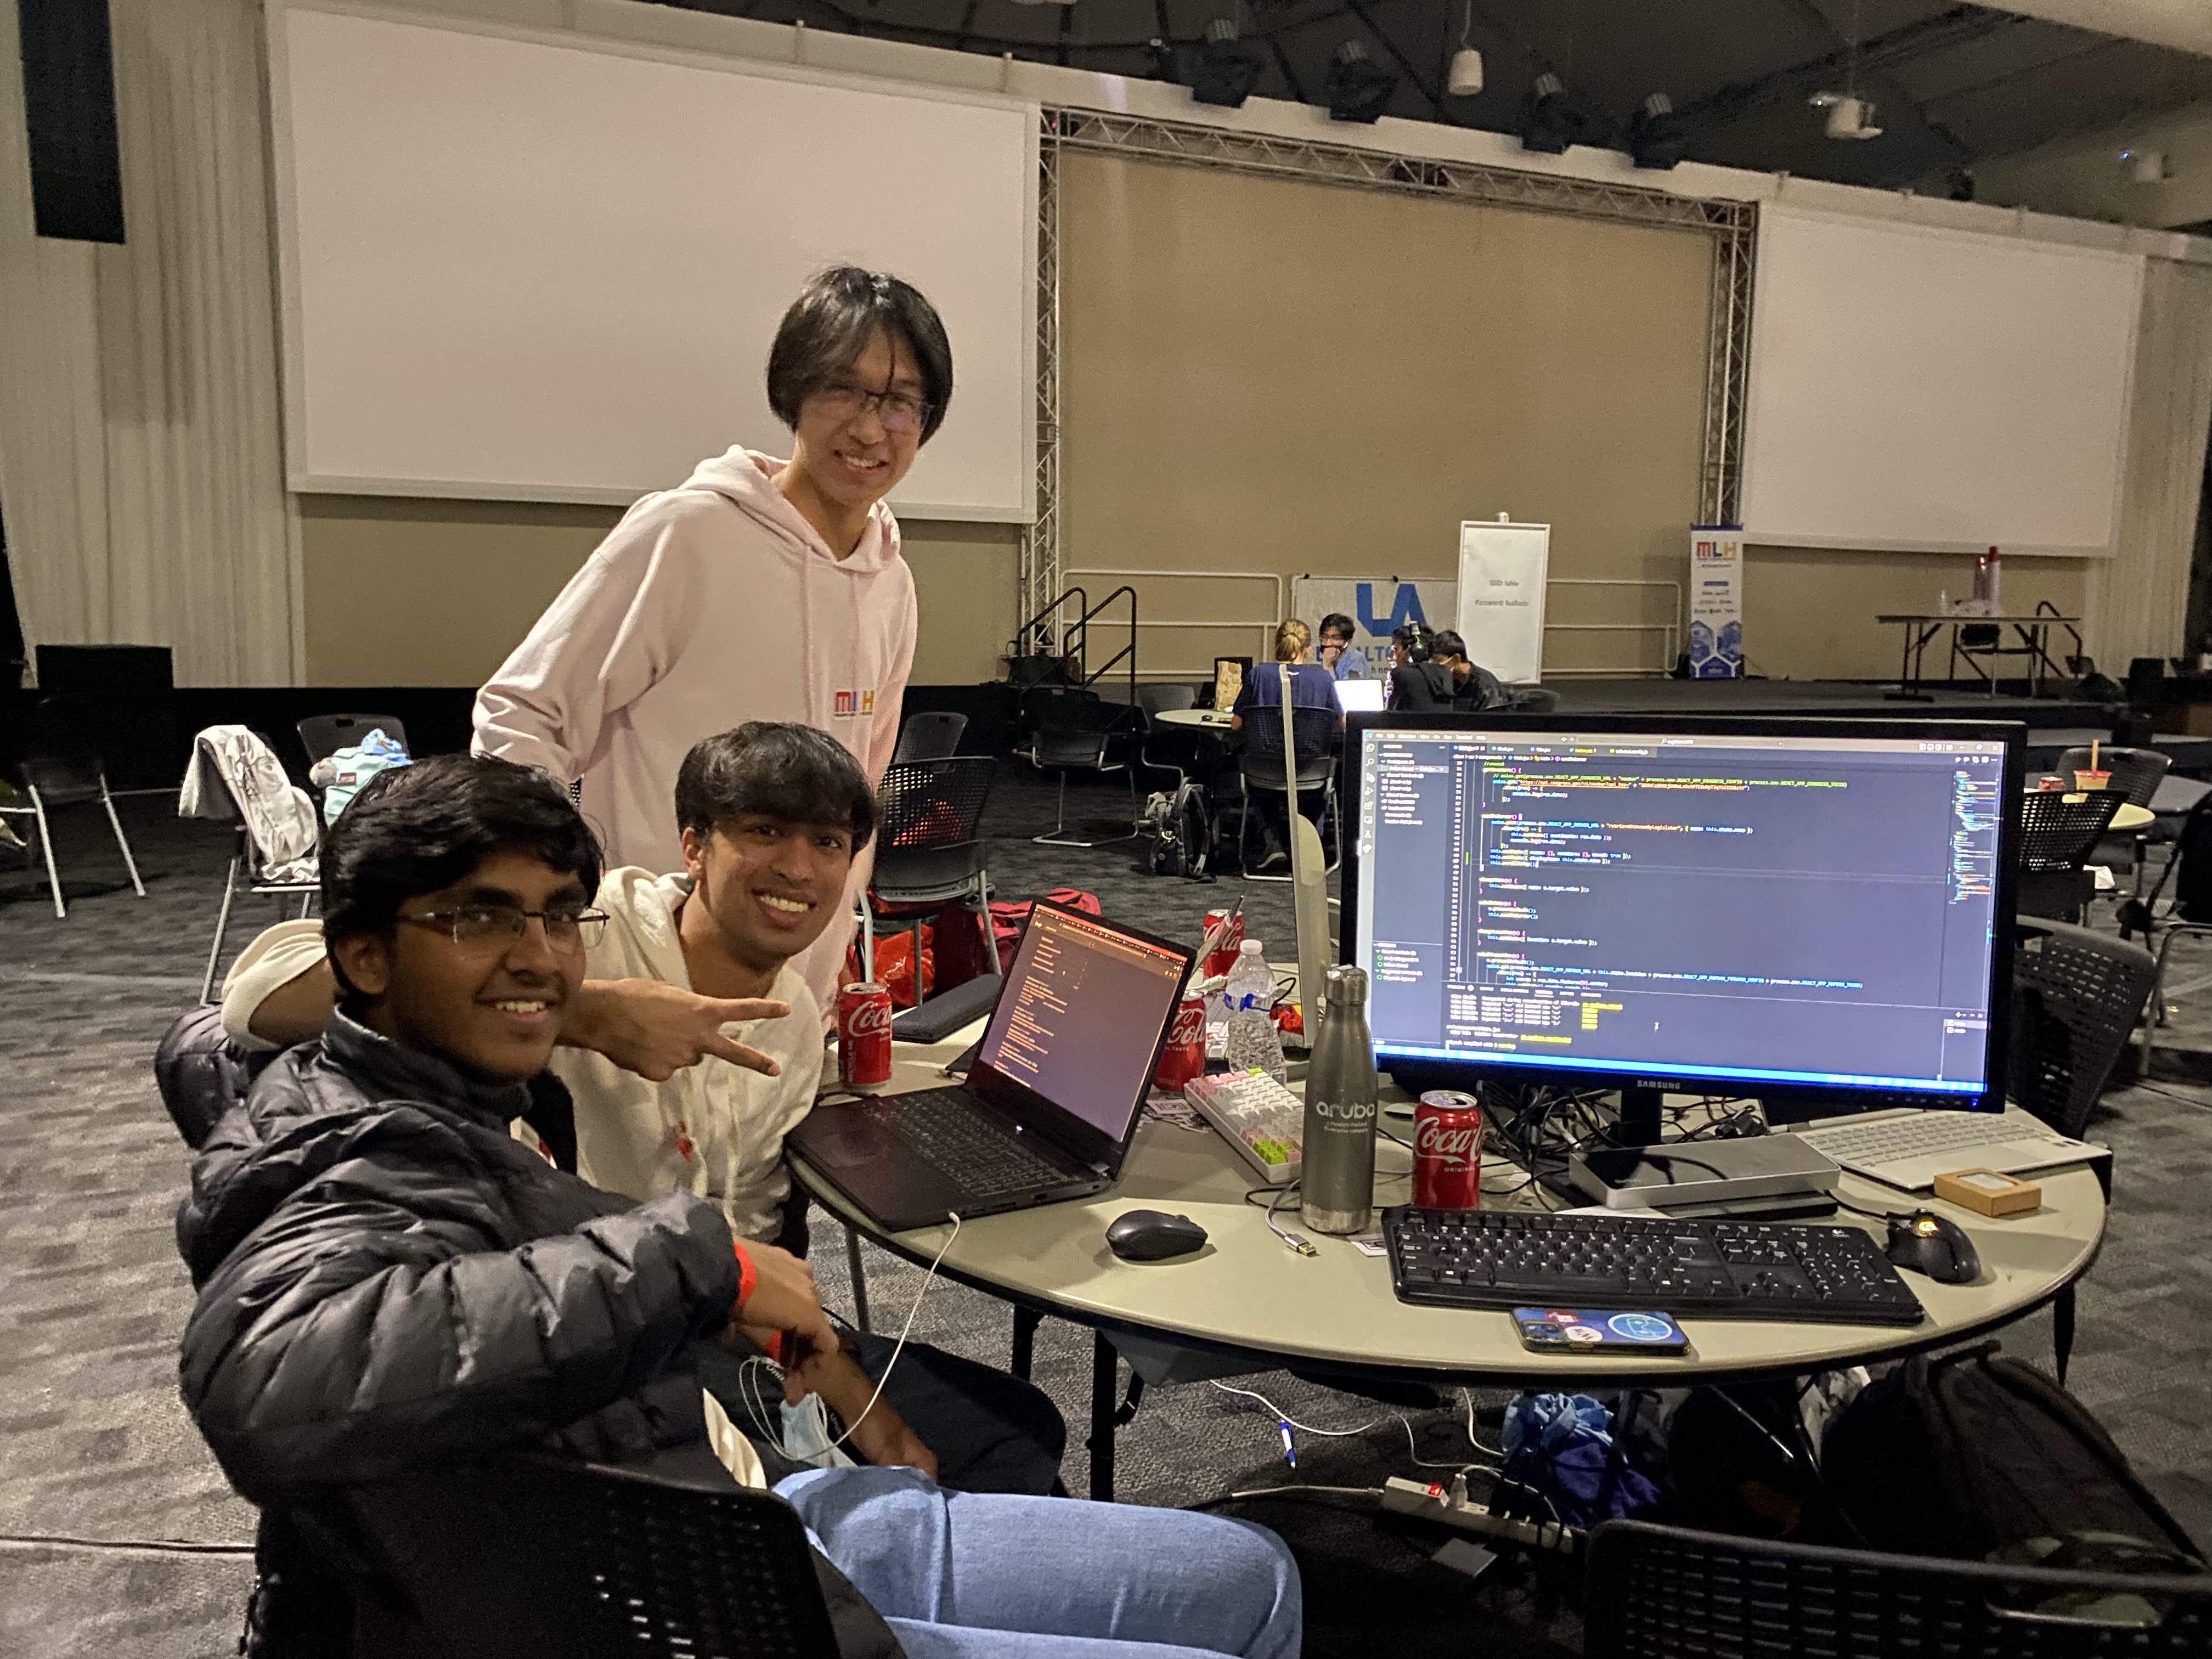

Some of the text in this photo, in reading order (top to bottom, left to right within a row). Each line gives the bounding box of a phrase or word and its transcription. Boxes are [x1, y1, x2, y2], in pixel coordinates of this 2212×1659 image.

[1696, 541, 1736, 557] MLH
[1637, 1080, 1680, 1090] SAMSUNG
[1317, 1102, 1375, 1119] aruba
